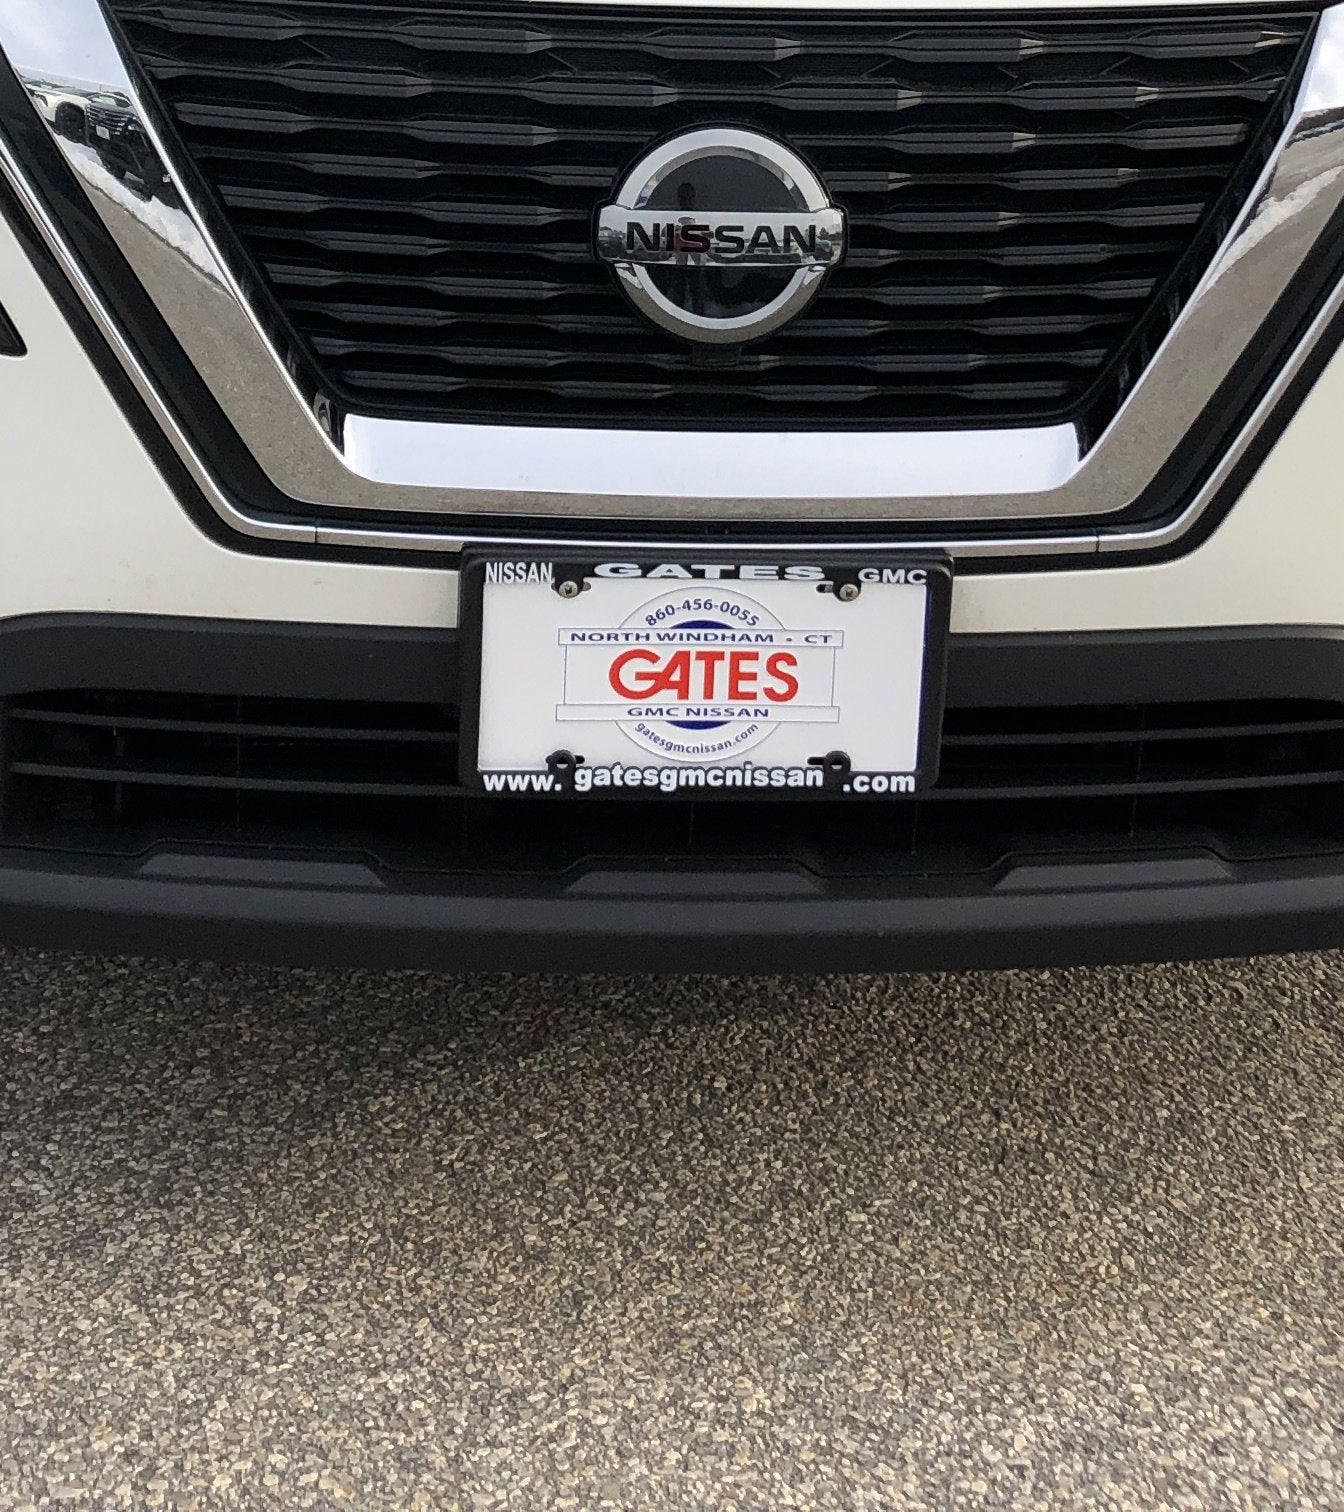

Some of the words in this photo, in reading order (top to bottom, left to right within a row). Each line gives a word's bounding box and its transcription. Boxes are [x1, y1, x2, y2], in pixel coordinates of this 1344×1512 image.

[626, 222, 817, 254] NISSAN
[485, 562, 552, 583] NISSAN
[594, 563, 825, 581] GATES
[858, 567, 928, 585] GMC
[645, 598, 760, 627] 860-456-0055
[570, 632, 650, 642] NORTH
[656, 632, 774, 643] WINDHAM
[804, 634, 833, 644] CT
[608, 648, 799, 703] GATES
[627, 707, 679, 717] GMC
[685, 707, 769, 718] NISSAN
[634, 722, 759, 755] gatesgmcnissan.com
